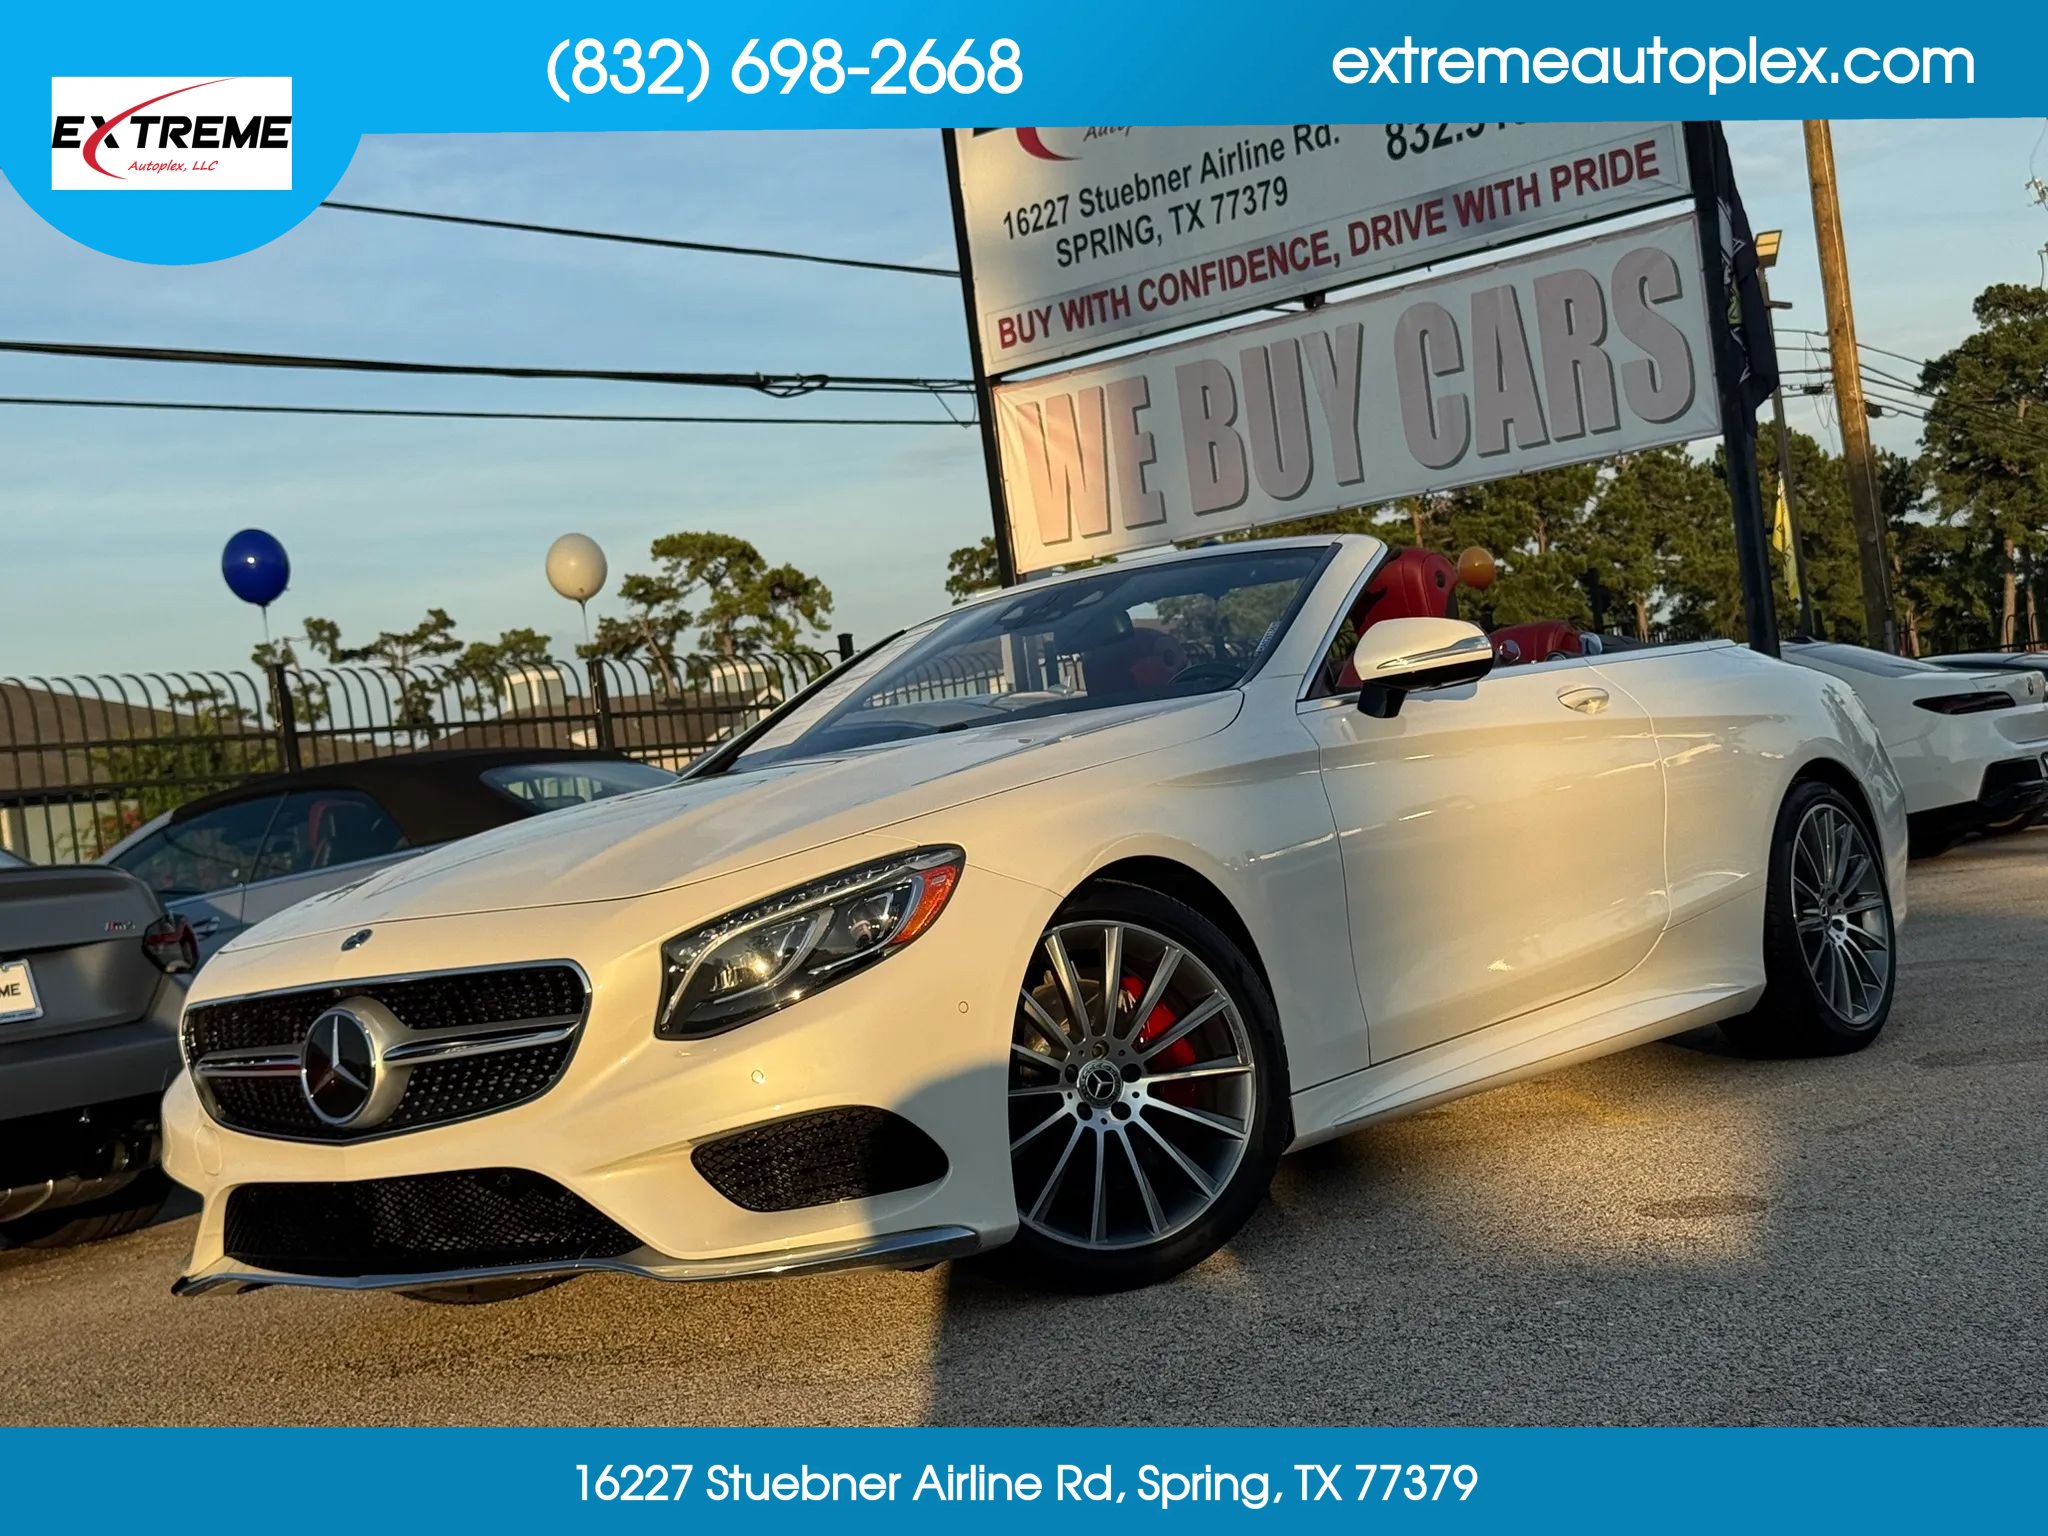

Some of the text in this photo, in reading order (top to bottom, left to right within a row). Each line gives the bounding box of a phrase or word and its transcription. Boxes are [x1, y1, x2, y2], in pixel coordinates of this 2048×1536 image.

[998, 140, 1660, 350] BUY WITH CONFIDENCE, DRIVE WITH PRIDE
[1003, 124, 1340, 240] 16227 Stuebner Airline Rd.
[1056, 176, 1288, 267] SPRING, TX 77379
[1015, 375, 1167, 545] WE
[1175, 322, 1364, 516] BUY
[1394, 247, 1695, 470] CARS
